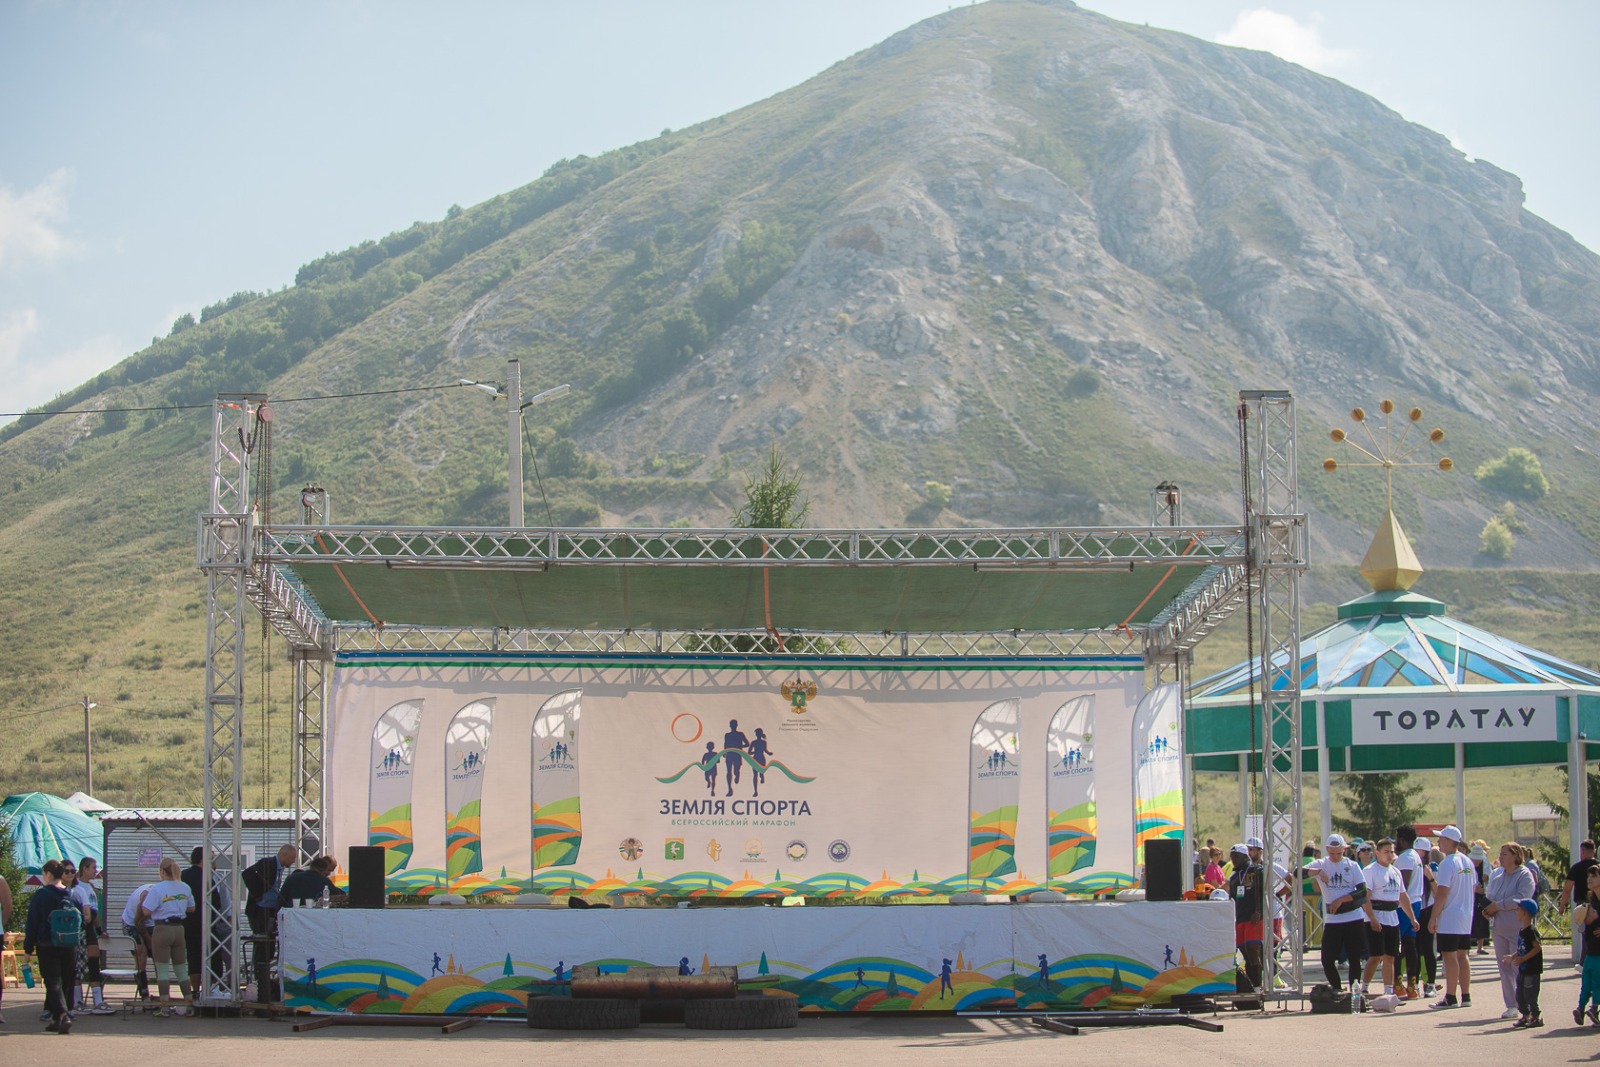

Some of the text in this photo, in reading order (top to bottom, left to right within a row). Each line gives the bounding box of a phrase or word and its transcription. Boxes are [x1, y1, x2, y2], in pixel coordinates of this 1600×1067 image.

[1373, 707, 1536, 731] ТОРАТАУ
[659, 799, 812, 816] ЗЕМЛЯ СПОРТА
[671, 818, 796, 827] ВСЕРОССИЙСКИЙ МАРАФОН
